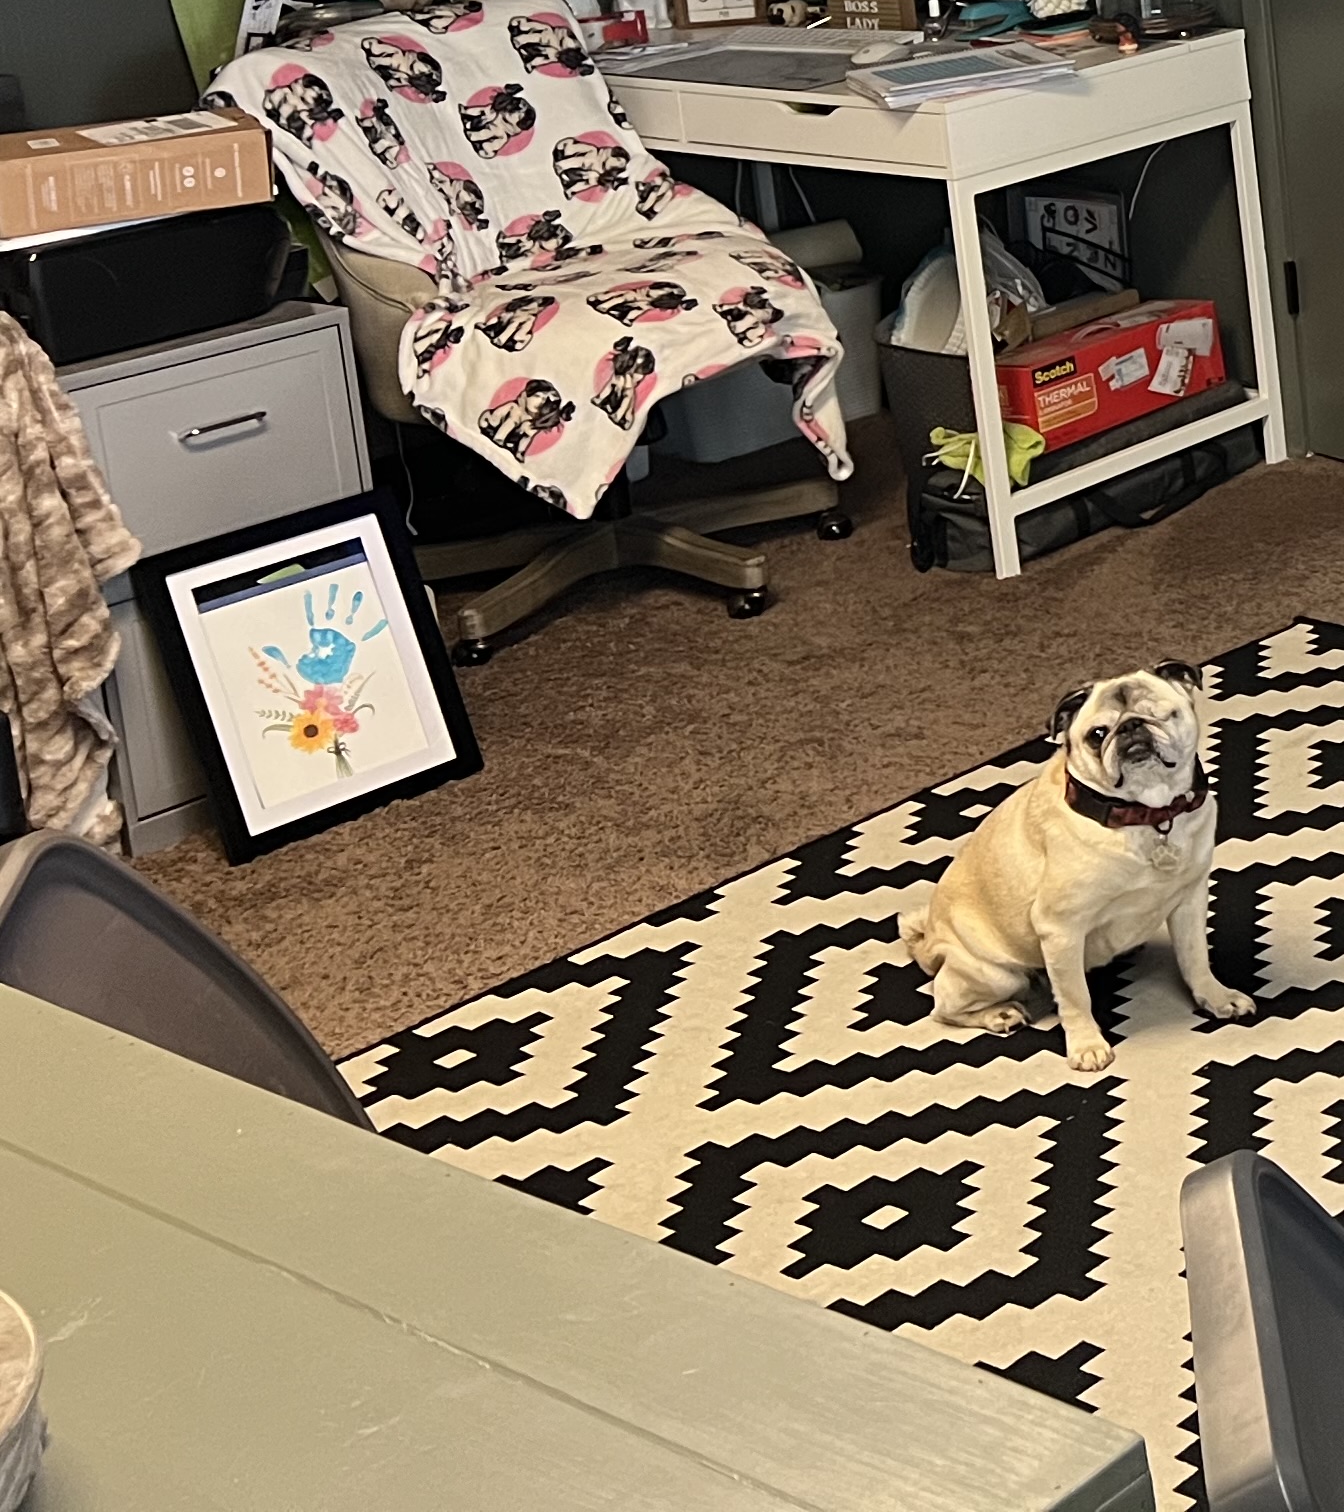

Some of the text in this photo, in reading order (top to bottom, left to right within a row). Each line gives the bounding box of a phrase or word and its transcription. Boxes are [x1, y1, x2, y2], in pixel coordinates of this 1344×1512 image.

[844, 0, 879, 13] BOSS
[846, 17, 880, 30] LADY
[1035, 361, 1074, 384] Scotch
[1038, 380, 1091, 408] THERMAL
